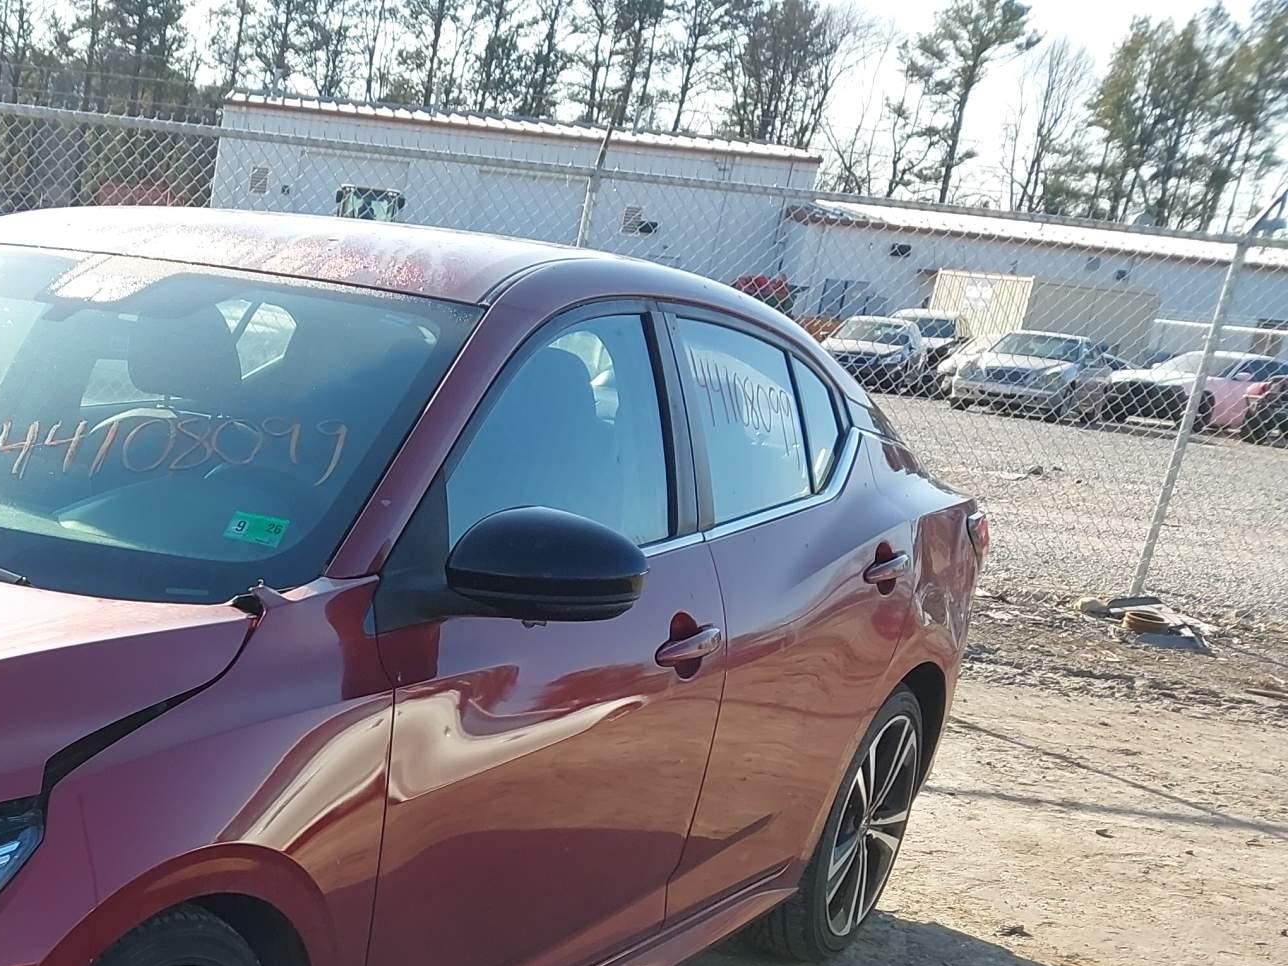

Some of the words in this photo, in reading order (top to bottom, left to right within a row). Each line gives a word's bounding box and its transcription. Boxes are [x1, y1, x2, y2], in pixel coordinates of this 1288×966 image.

[688, 343, 801, 471] 44108099
[235, 520, 247, 532] 9
[265, 522, 283, 535] 26
